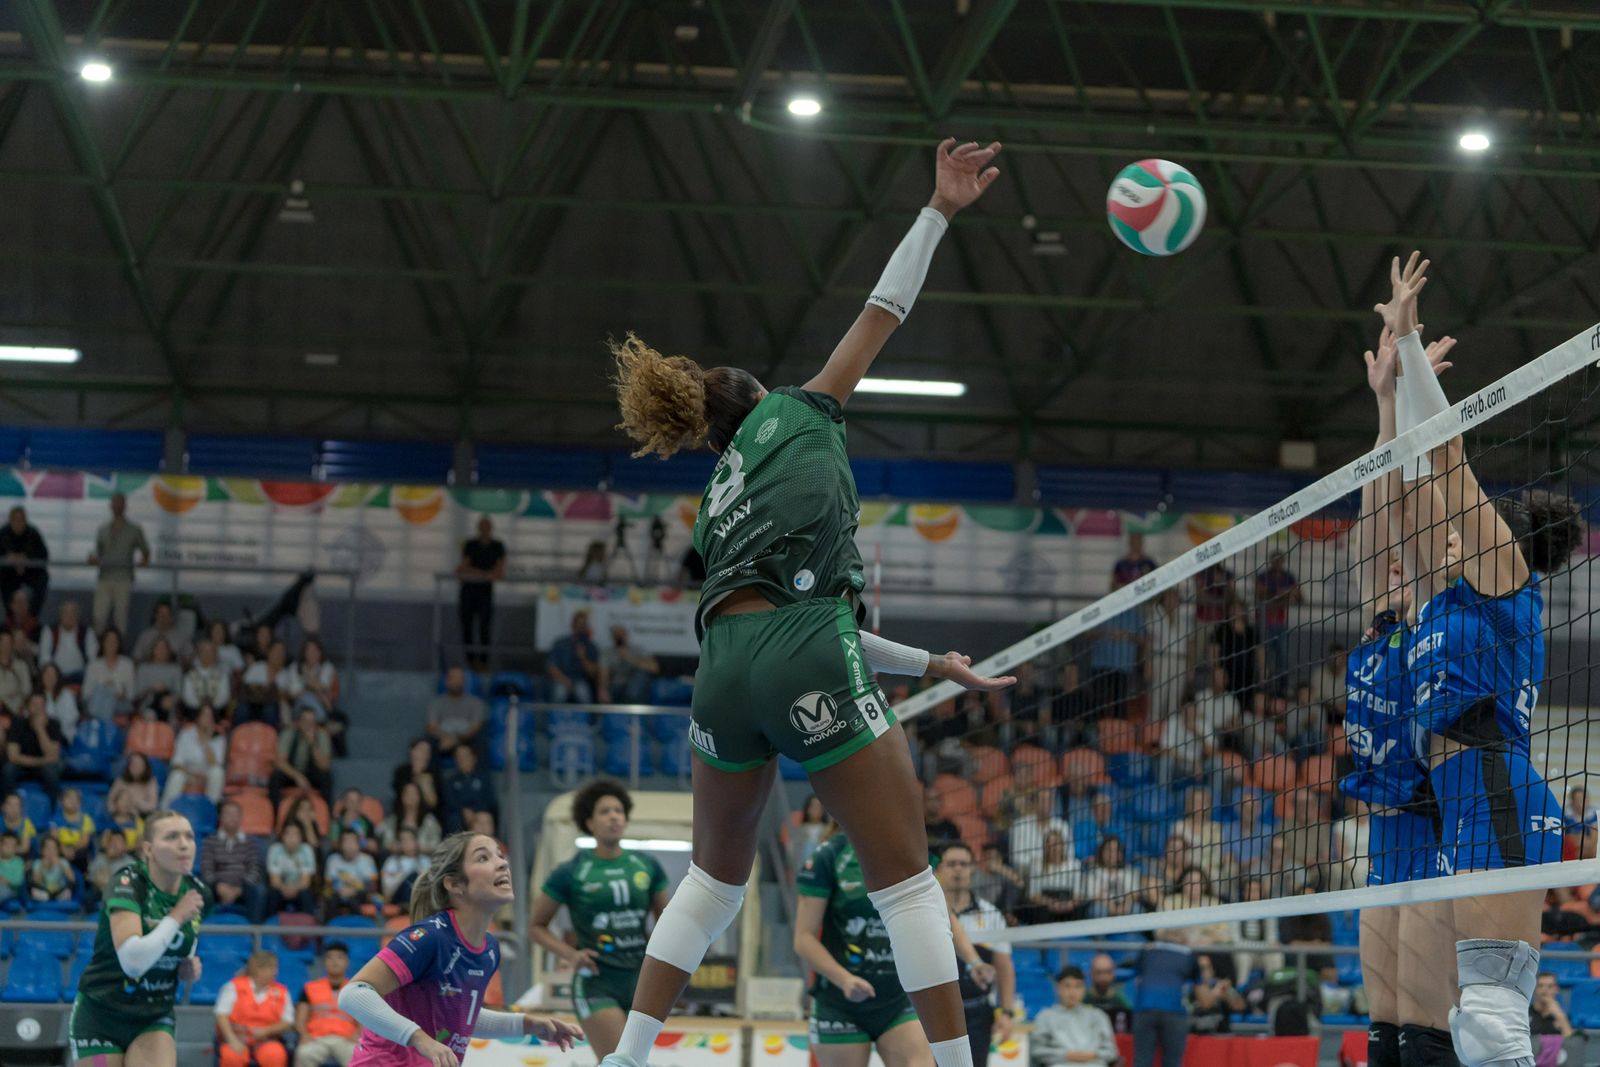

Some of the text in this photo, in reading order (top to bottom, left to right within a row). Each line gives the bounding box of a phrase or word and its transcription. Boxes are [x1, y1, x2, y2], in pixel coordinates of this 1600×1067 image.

[1460, 386, 1507, 423] rfevb.com
[1354, 448, 1392, 480] rfevb.com
[708, 449, 746, 518] 8
[713, 498, 752, 538] WAY
[1268, 501, 1301, 527] rfevb.com
[864, 702, 879, 720] 8
[608, 879, 630, 907] 11
[466, 989, 478, 1025] 1
